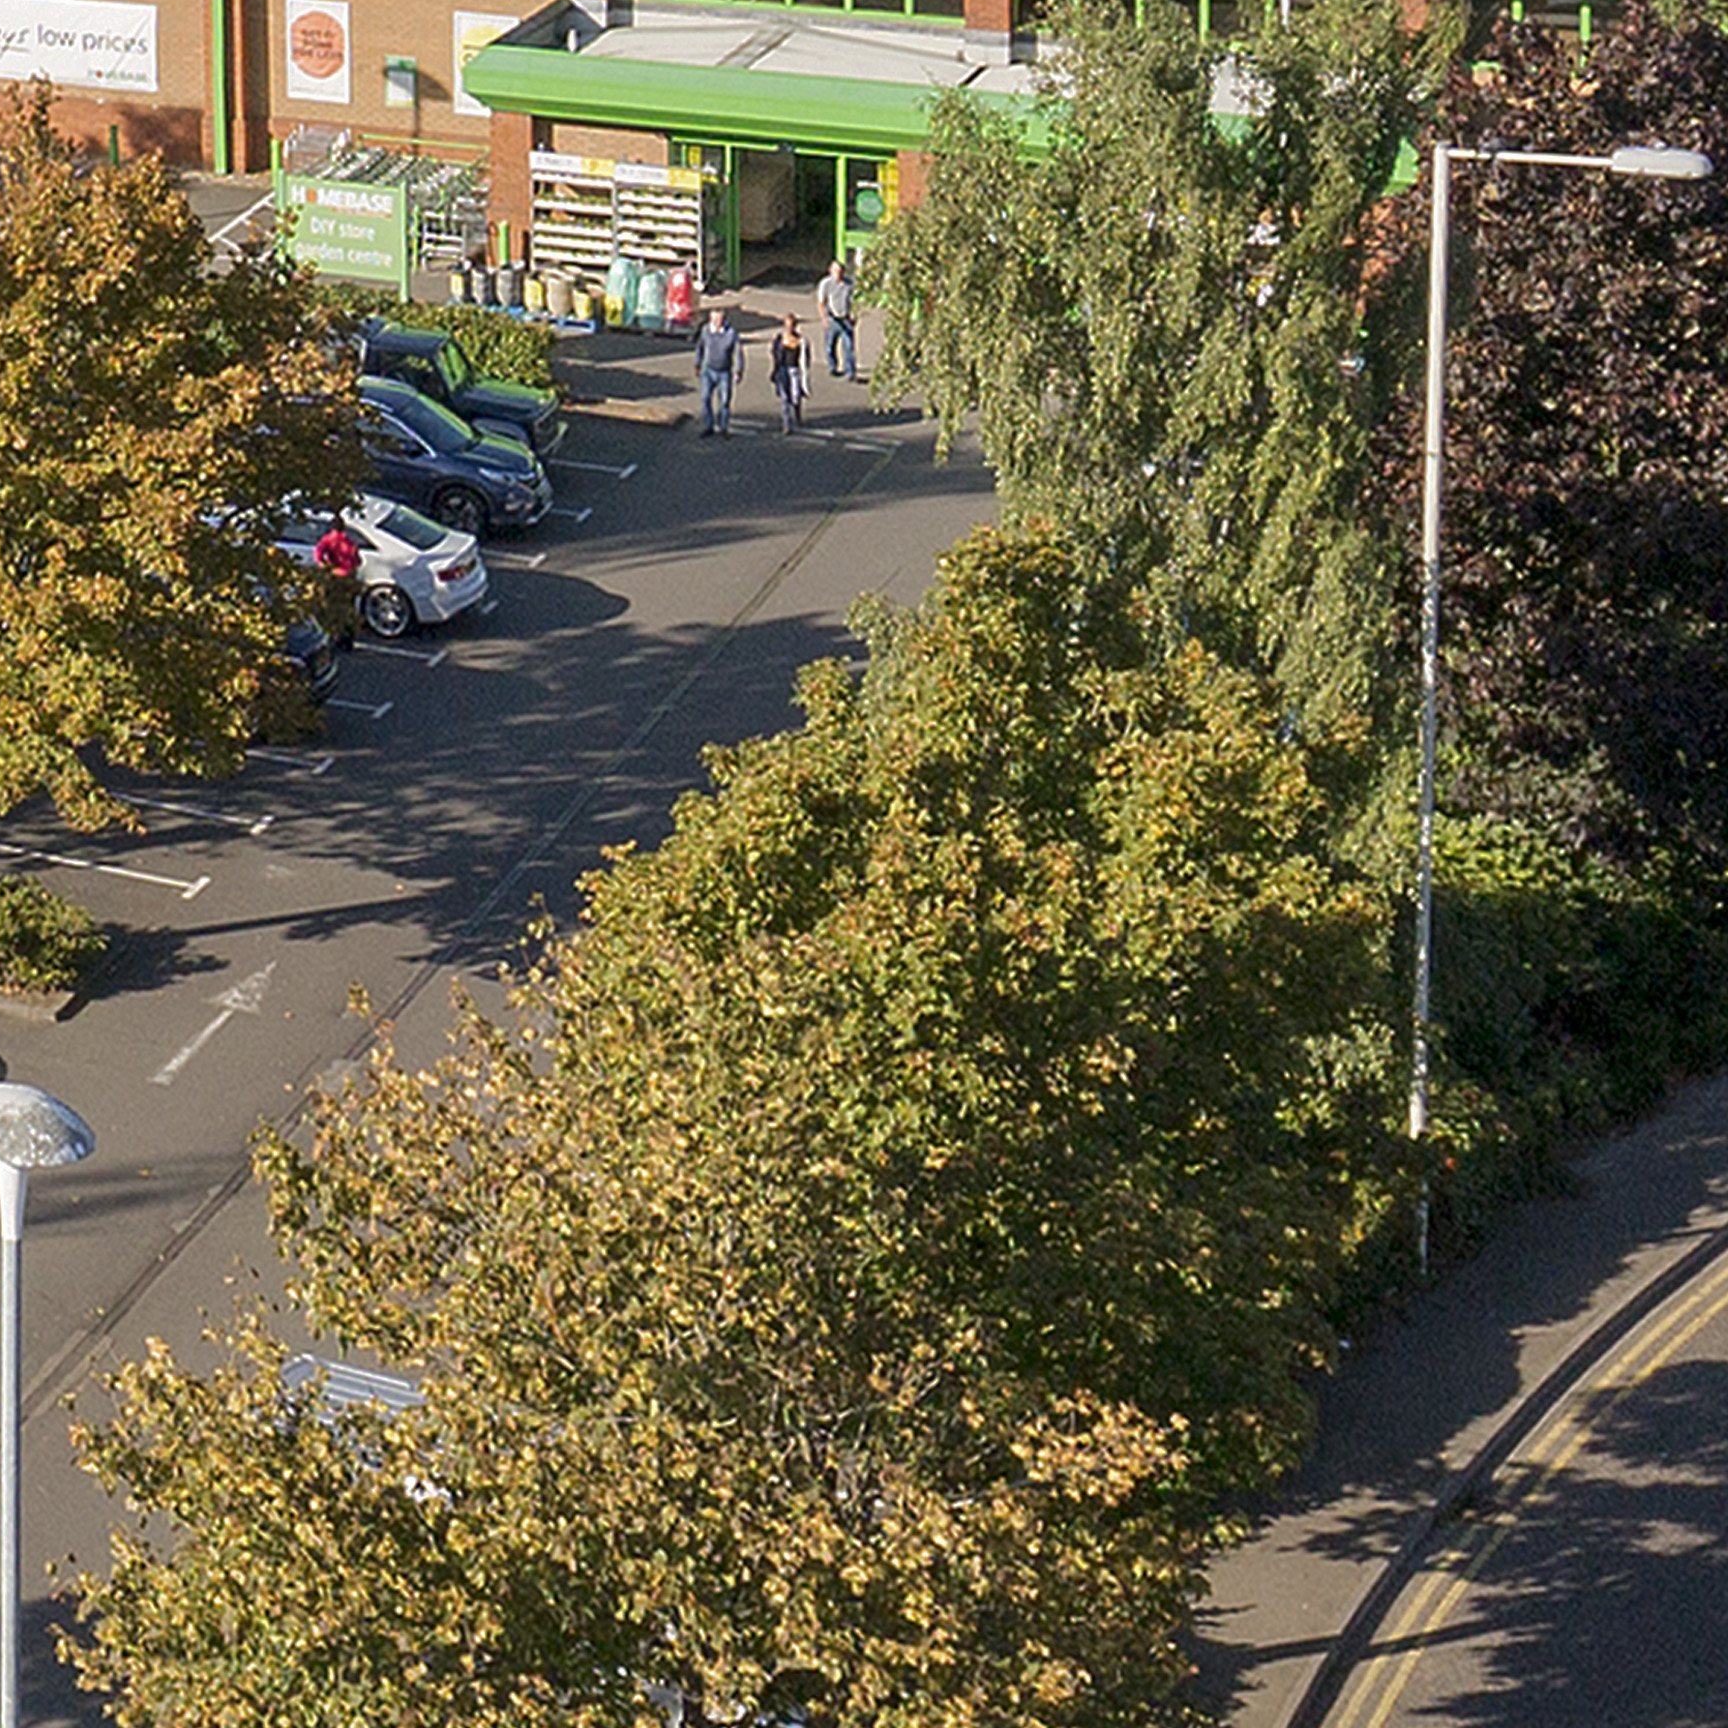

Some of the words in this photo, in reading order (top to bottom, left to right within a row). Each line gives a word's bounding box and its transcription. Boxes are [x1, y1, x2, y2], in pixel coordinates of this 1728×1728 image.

[37, 24, 76, 48] low
[82, 29, 149, 56] prices
[292, 185, 393, 213] HOMEBASE
[310, 216, 336, 236] DIY
[339, 223, 375, 241] store
[347, 249, 393, 267] centre
